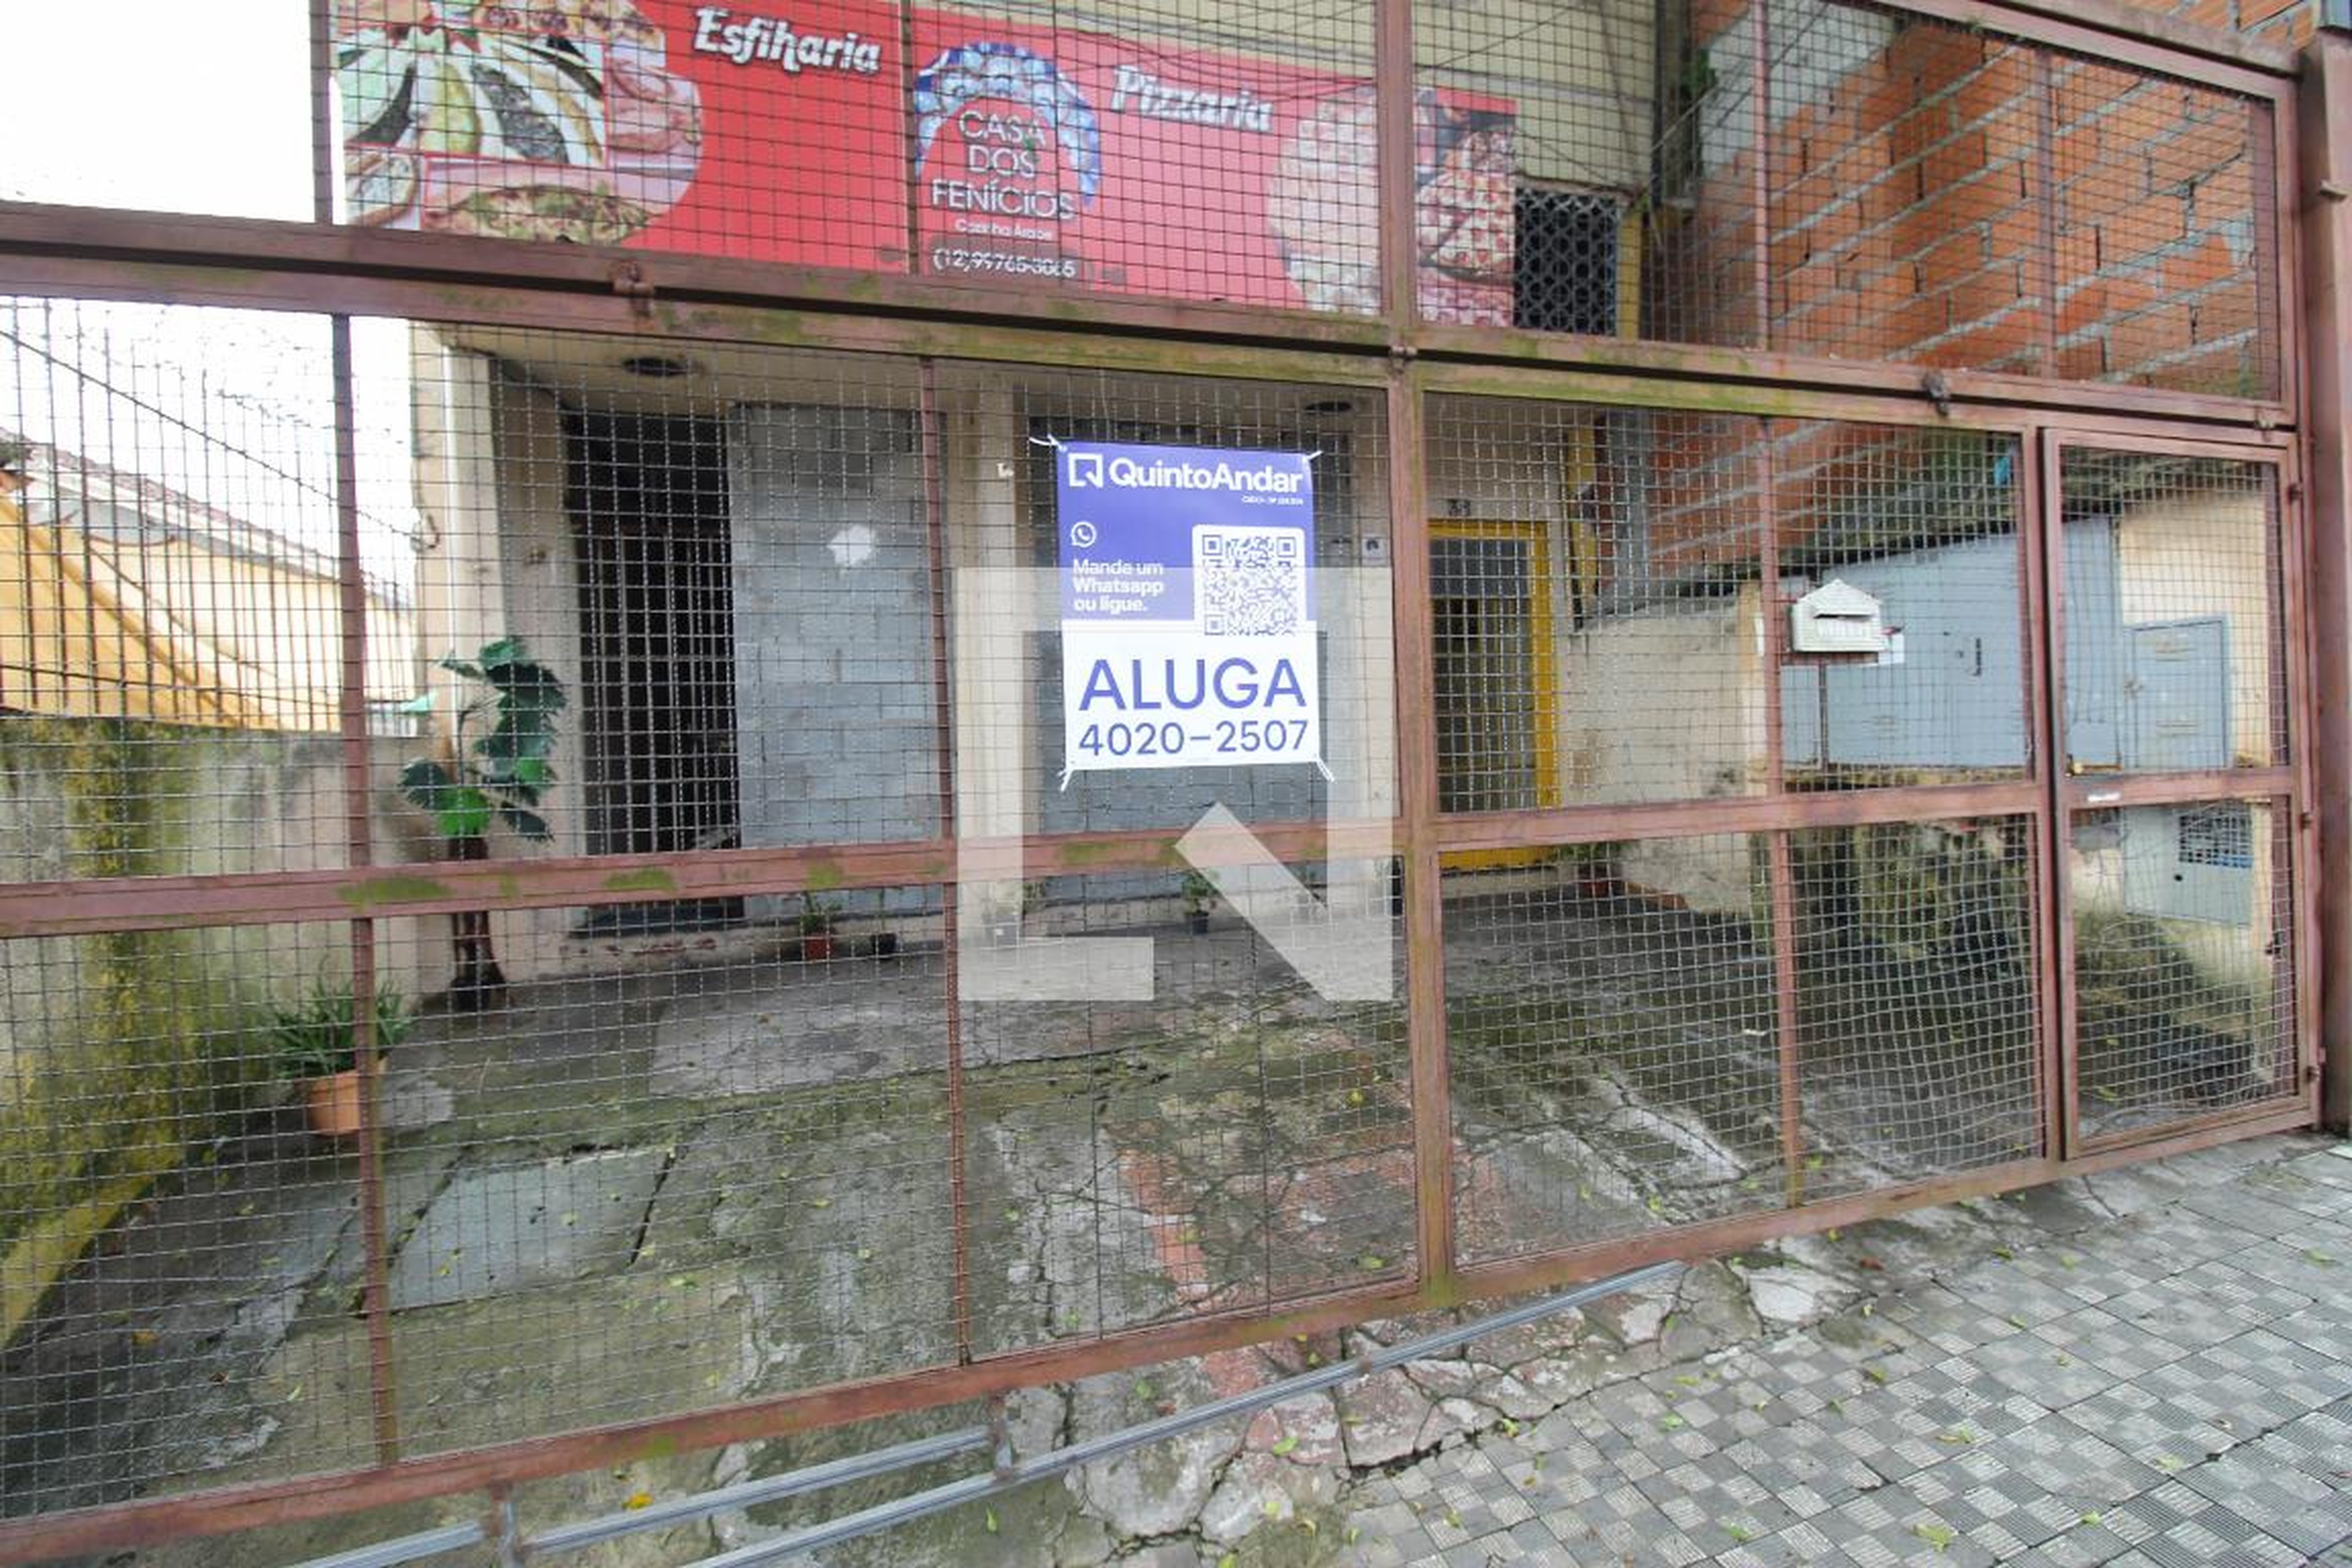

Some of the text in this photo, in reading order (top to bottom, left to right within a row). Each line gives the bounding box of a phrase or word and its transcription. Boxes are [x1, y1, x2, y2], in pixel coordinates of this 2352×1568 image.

[694, 6, 881, 72] Esfiharia
[1111, 64, 1273, 131] Pizzaria
[959, 110, 1046, 146] CASA
[968, 144, 1035, 179] DOS
[932, 178, 1076, 219] FENÍCIOS
[1109, 456, 1303, 493] QuintoAndar
[1073, 576, 1164, 597] Whatsapp
[1136, 562, 1163, 575] um
[1074, 595, 1148, 614] ou ligue.
[1079, 657, 1307, 712] ALUGA
[1079, 720, 1308, 756] 4020-2507
